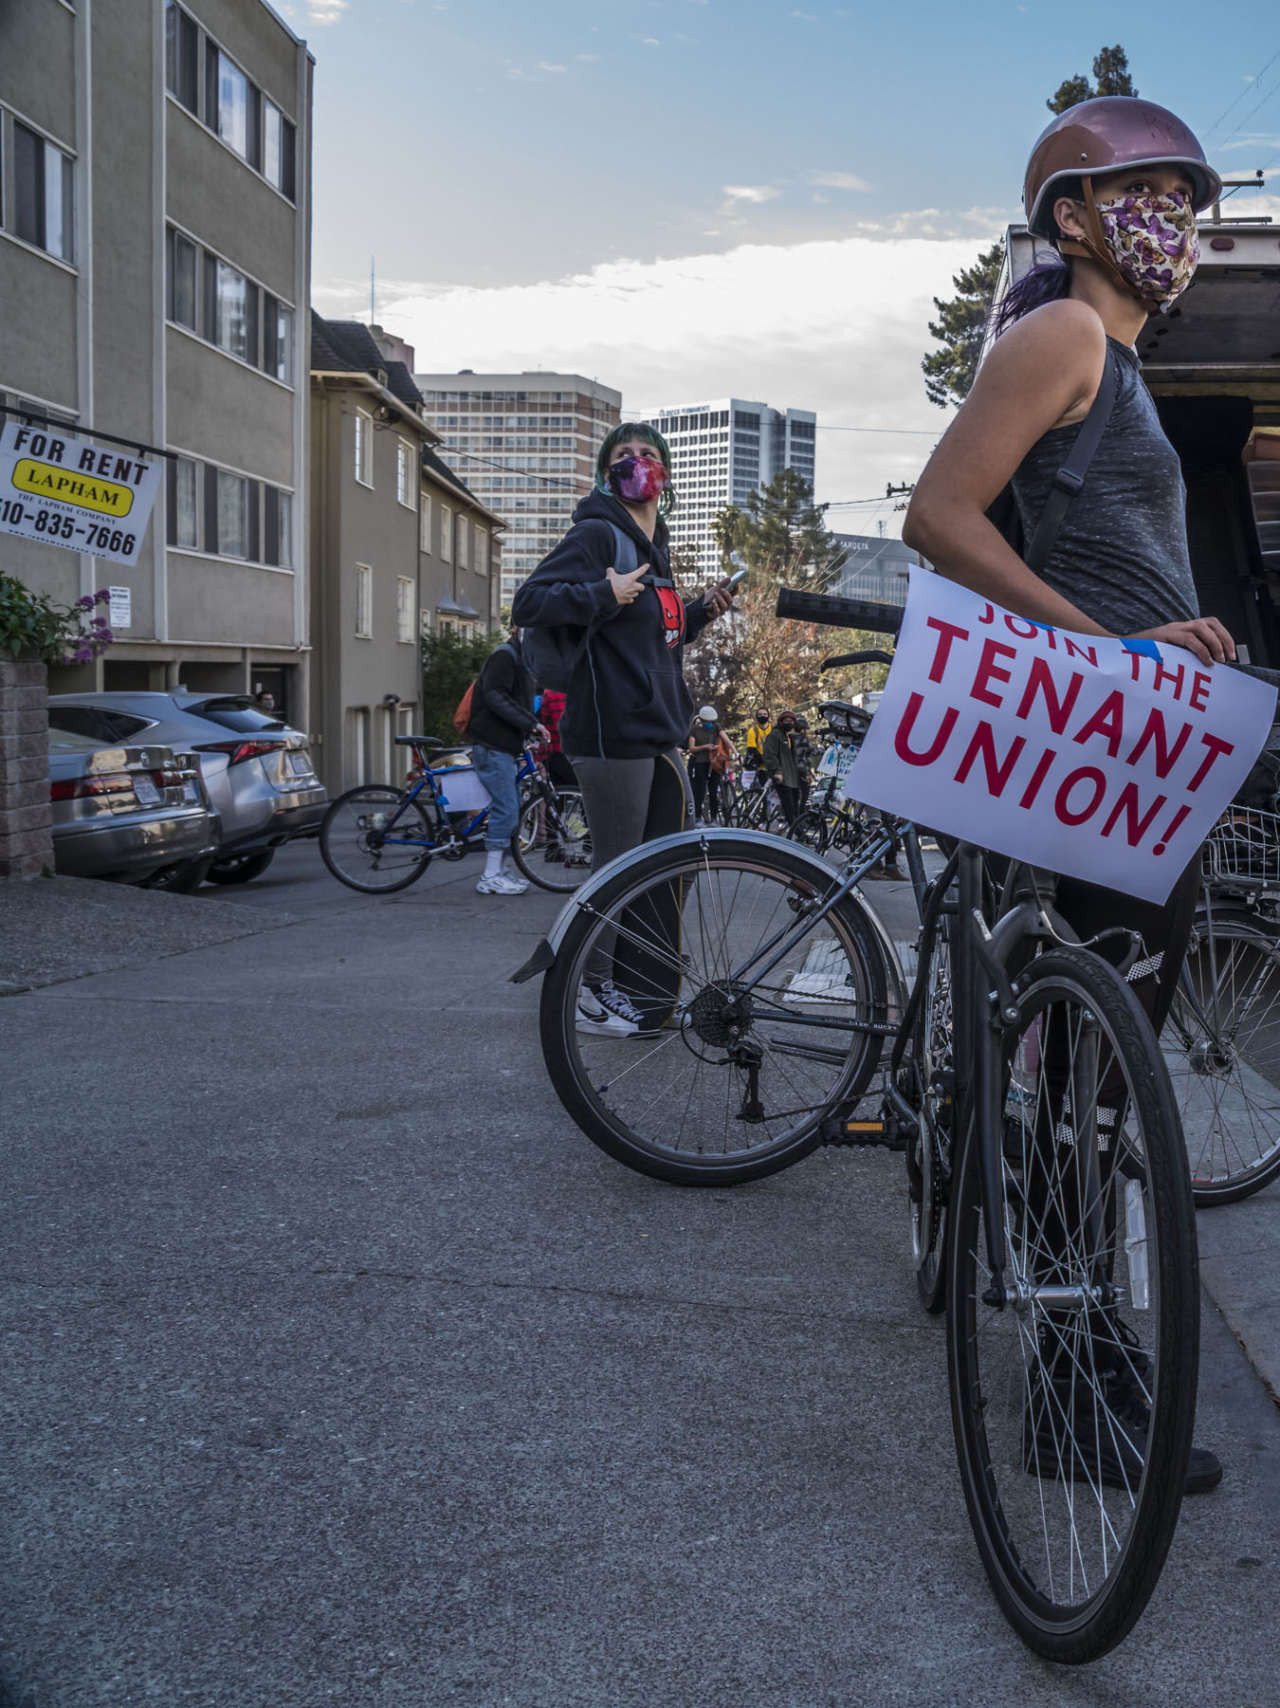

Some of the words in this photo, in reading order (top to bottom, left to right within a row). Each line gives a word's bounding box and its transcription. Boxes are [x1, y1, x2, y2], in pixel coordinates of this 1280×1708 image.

[13, 429, 66, 463] FOR
[78, 447, 149, 485] RENT
[27, 469, 120, 506] LAPHAM
[0, 497, 136, 556] 10-835-7666
[978, 602, 1099, 668] JOIN
[1121, 648, 1212, 713] THE
[927, 617, 1235, 793] TENANT
[894, 692, 1192, 856] UNION!
